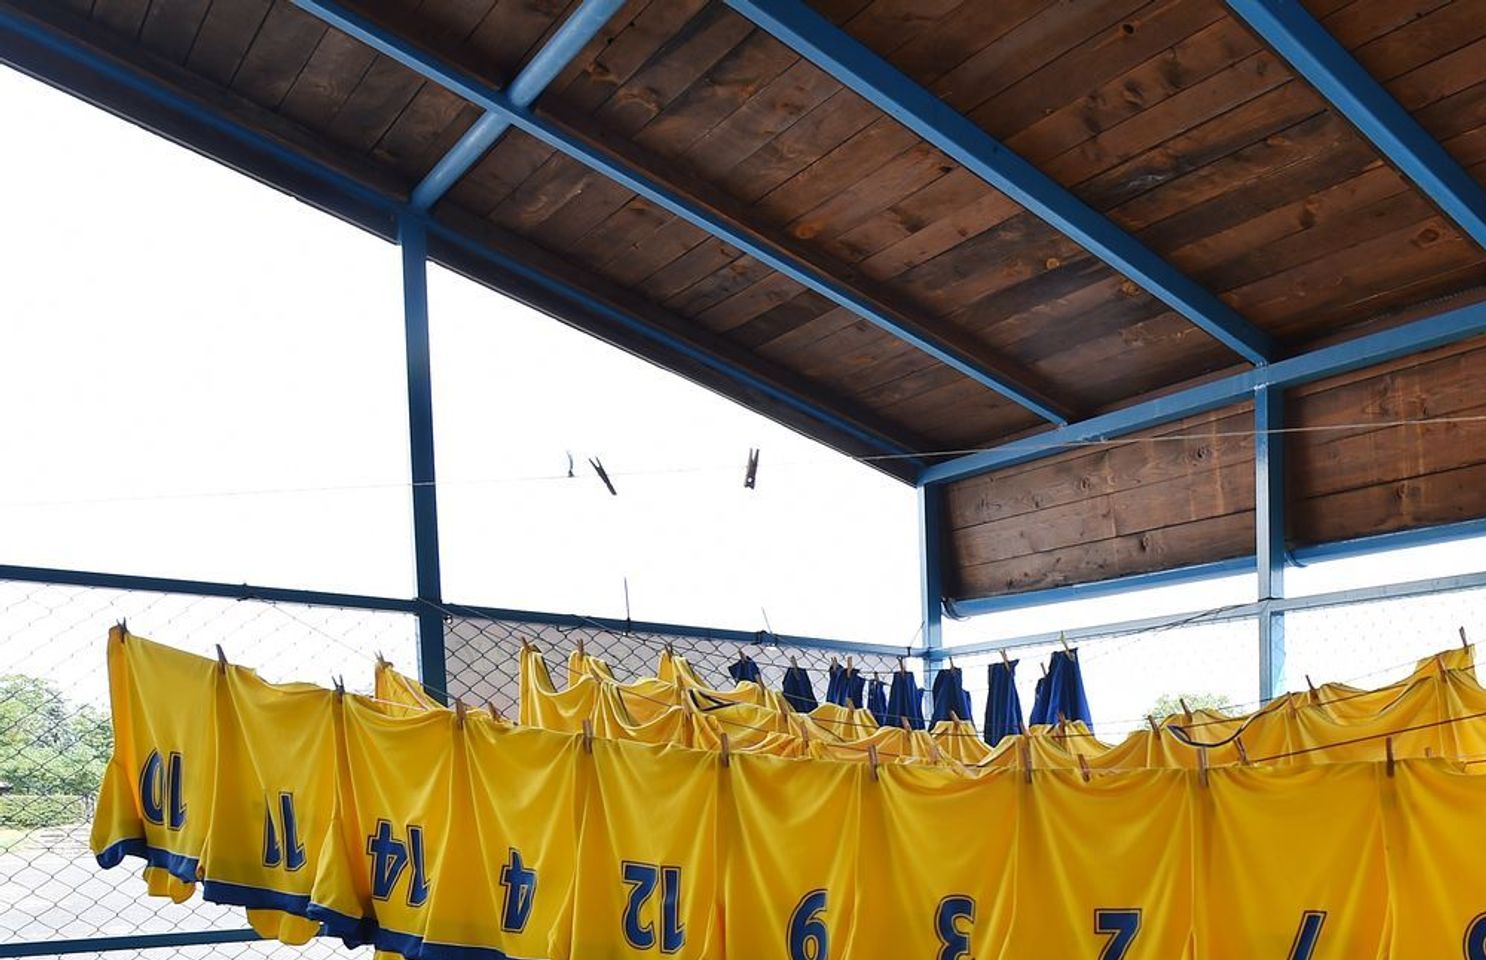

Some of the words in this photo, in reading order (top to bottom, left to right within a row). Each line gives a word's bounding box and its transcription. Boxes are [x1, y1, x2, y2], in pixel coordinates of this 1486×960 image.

[139, 747, 187, 831] 10
[262, 791, 307, 872] 11
[366, 818, 432, 908] 14
[500, 847, 538, 933] 4
[621, 860, 687, 954] 12
